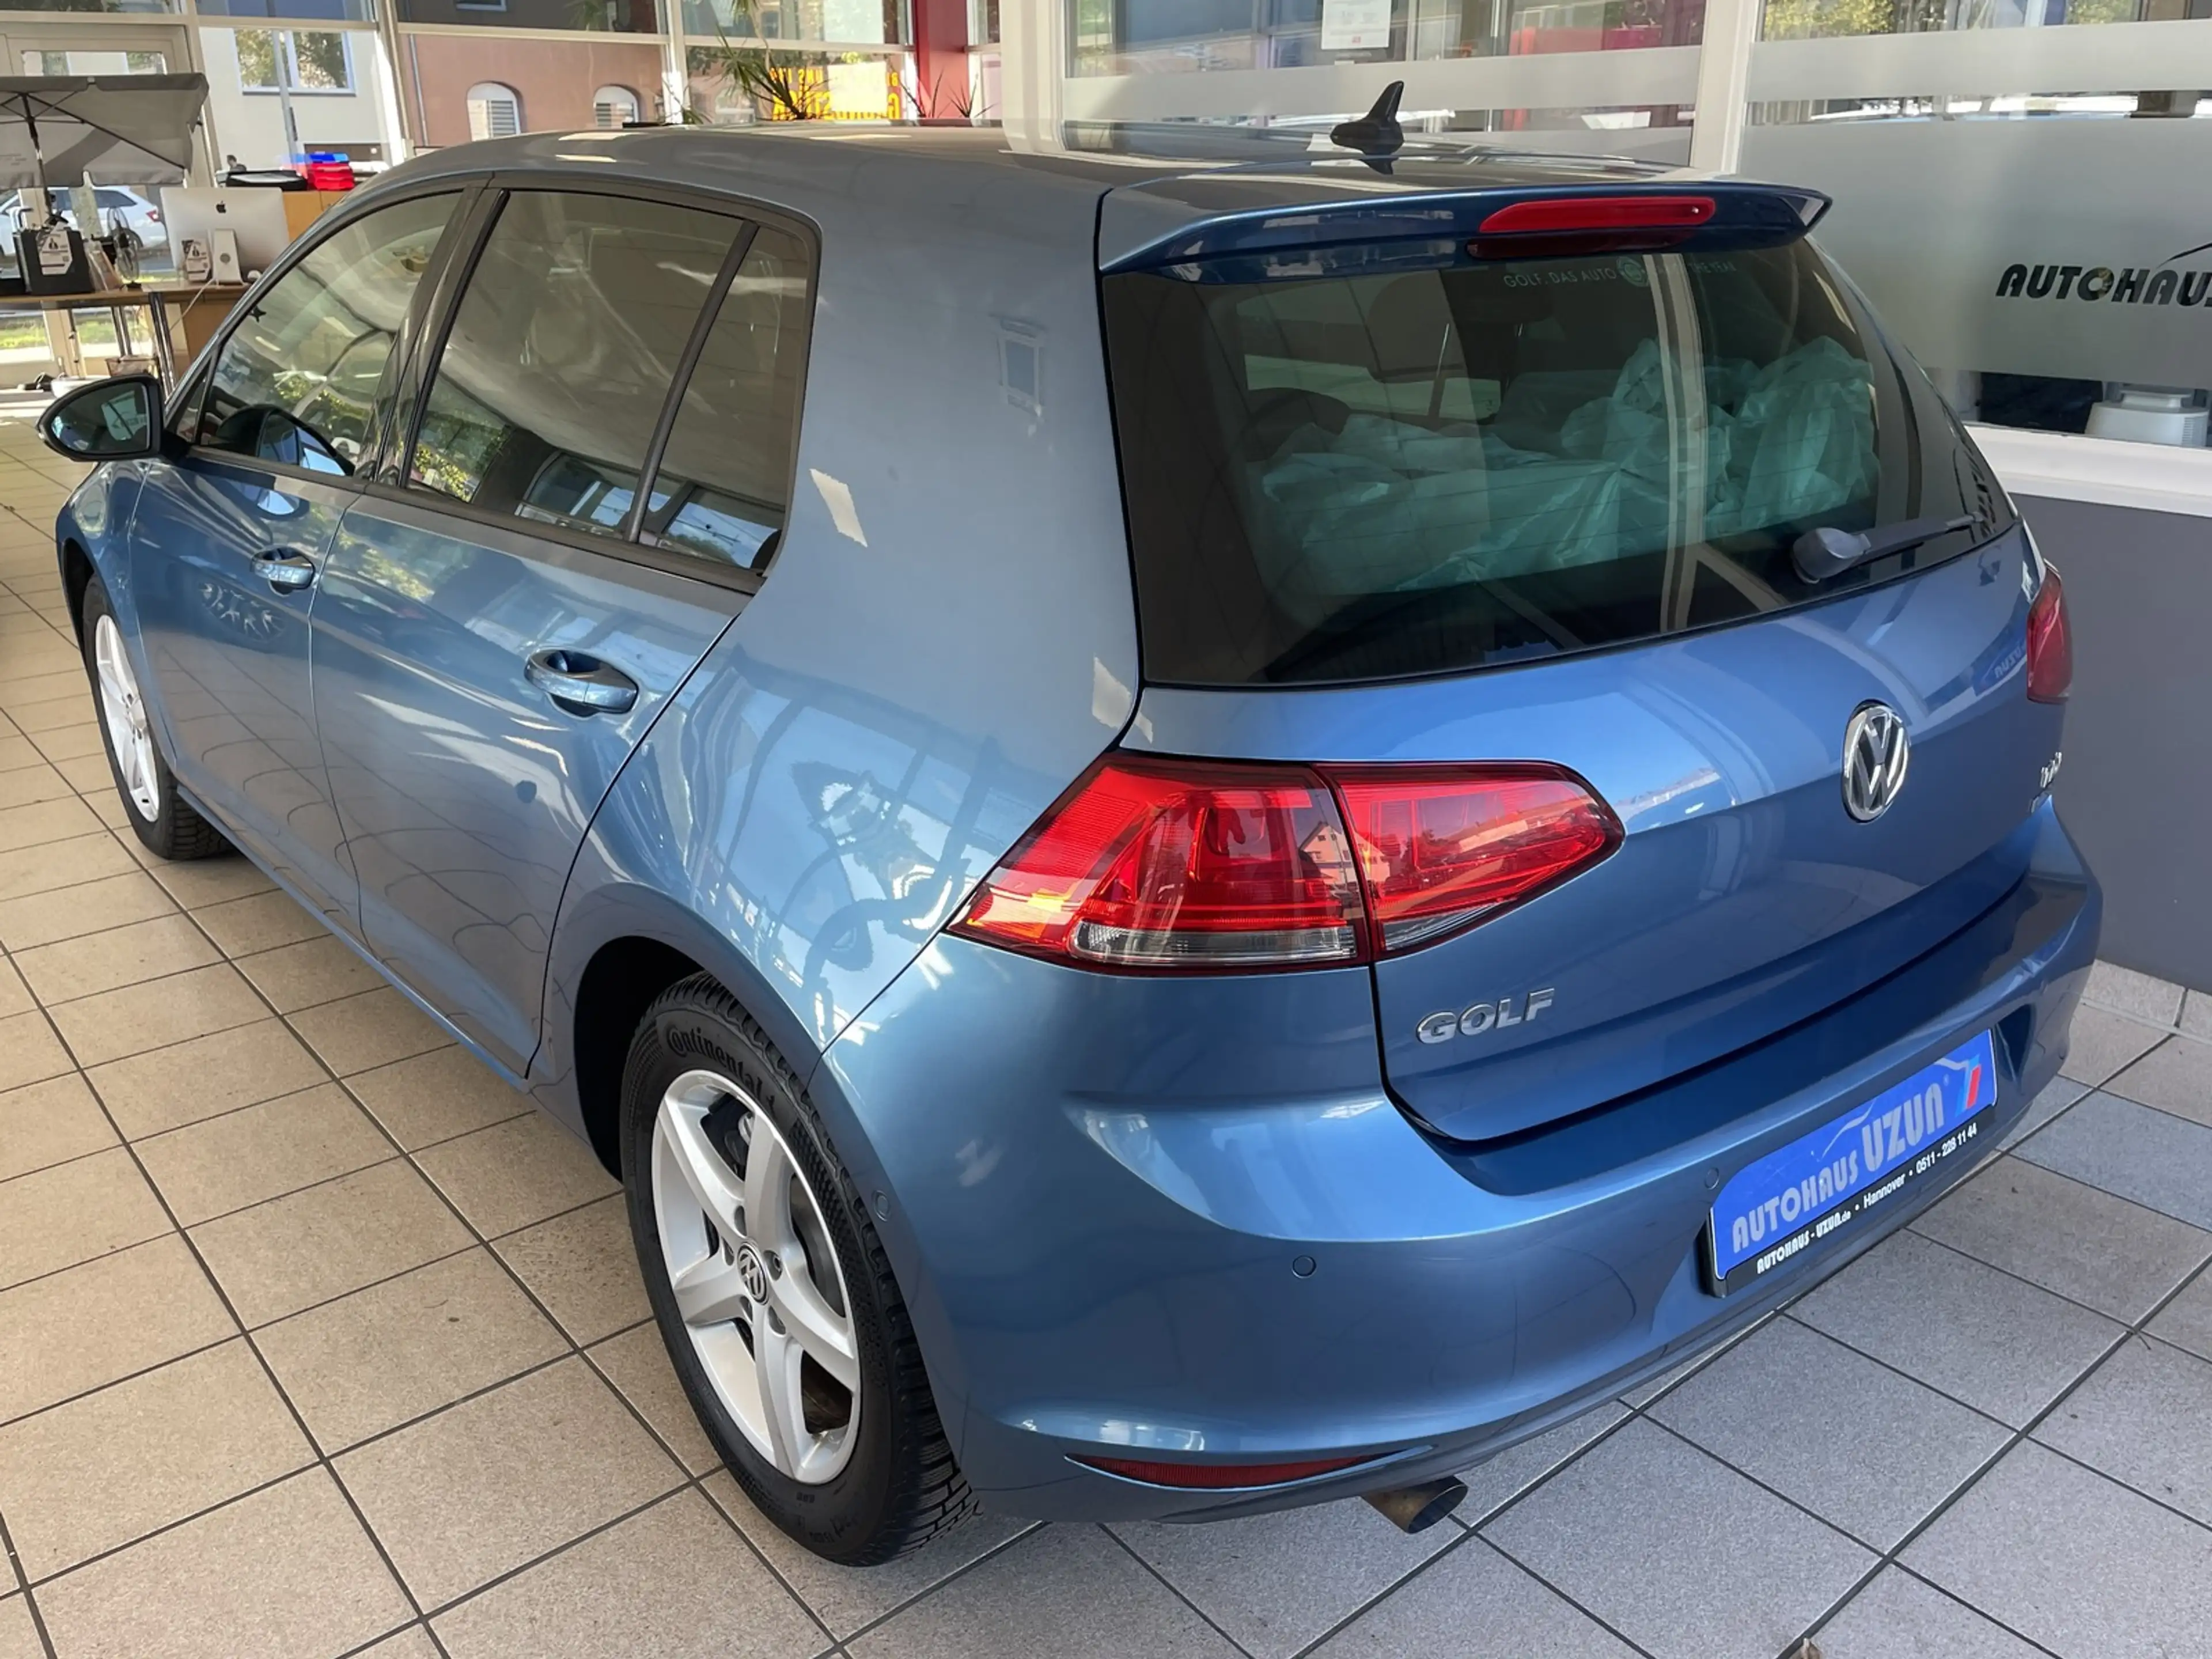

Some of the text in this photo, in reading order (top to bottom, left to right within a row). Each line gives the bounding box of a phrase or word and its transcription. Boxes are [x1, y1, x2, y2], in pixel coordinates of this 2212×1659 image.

[1548, 271, 1578, 284] DAS
[1581, 267, 1617, 281] AUTO
[1416, 987, 1555, 1044] GOLF
[1732, 1082, 1945, 1254] AUTOHAUS UZUN
[1757, 1230, 1810, 1274] AUTOHAUS
[1863, 1173, 1906, 1209] Hannover
[1915, 1150, 1936, 1174] 0511
[1957, 1130, 1966, 1146] 11
[1967, 1122, 1977, 1138] 44
